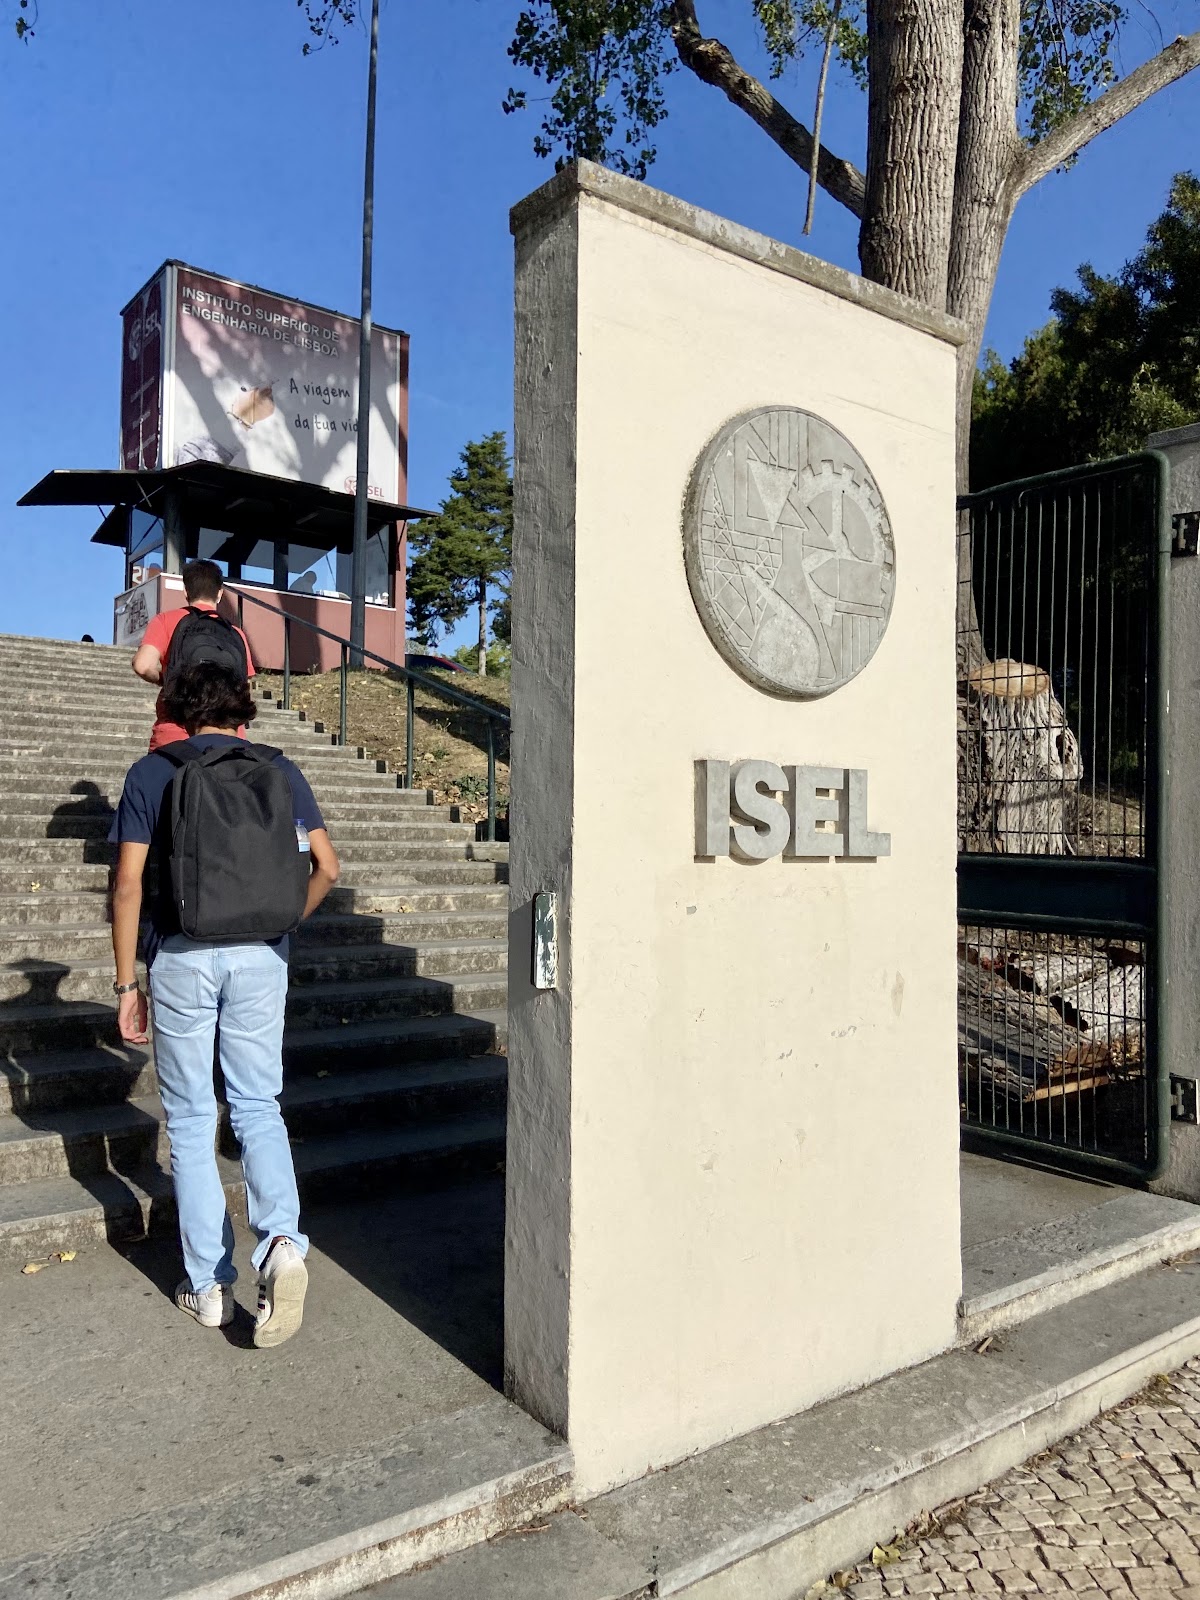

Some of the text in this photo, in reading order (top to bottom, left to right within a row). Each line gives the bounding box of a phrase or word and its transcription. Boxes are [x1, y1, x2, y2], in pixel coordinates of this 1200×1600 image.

[182, 286, 340, 343] INSTITUTO SUPERIOR DE
[182, 303, 270, 338] ENGENHARIA
[273, 329, 290, 344] DE
[293, 335, 339, 358] LISBOA
[289, 377, 351, 405] A viagem
[294, 413, 359, 432] da tua vid
[367, 485, 385, 498] SEL
[694, 759, 892, 863] ISEL
